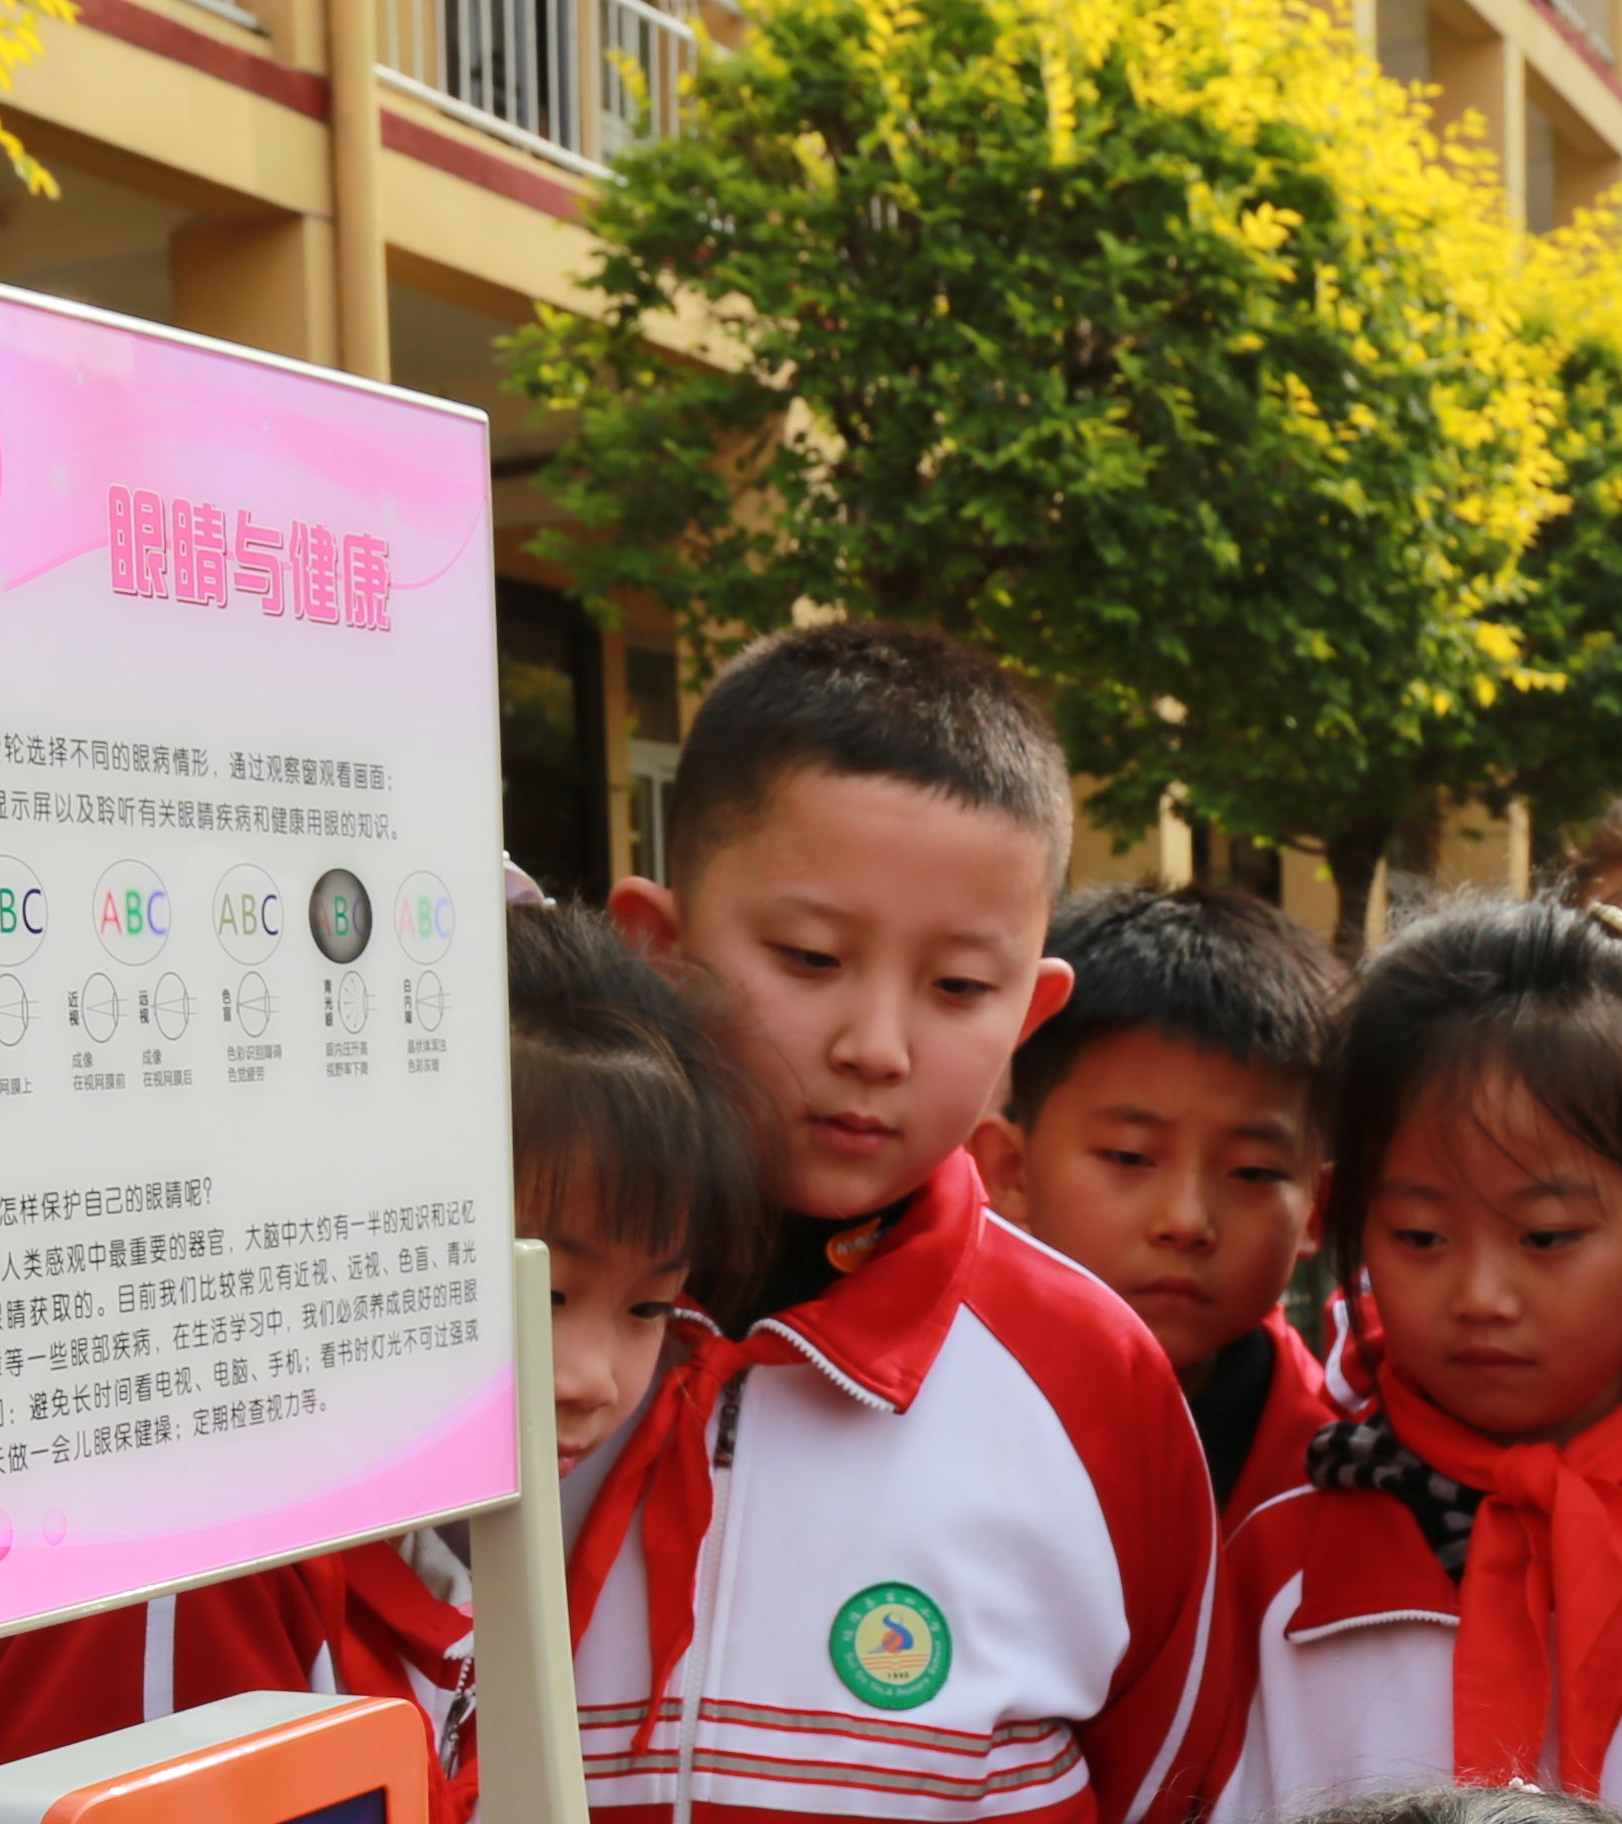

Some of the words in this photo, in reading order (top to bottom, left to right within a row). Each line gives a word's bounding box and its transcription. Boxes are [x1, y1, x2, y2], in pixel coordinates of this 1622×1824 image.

[108, 483, 391, 631] 眼睛与健康
[100, 889, 167, 936] ABC
[218, 893, 279, 936] ABC
[314, 895, 366, 937] ABC
[399, 896, 450, 941] ABC
[73, 1073, 125, 1091] 在视网膜前
[143, 1069, 193, 1087] 在视网膜后
